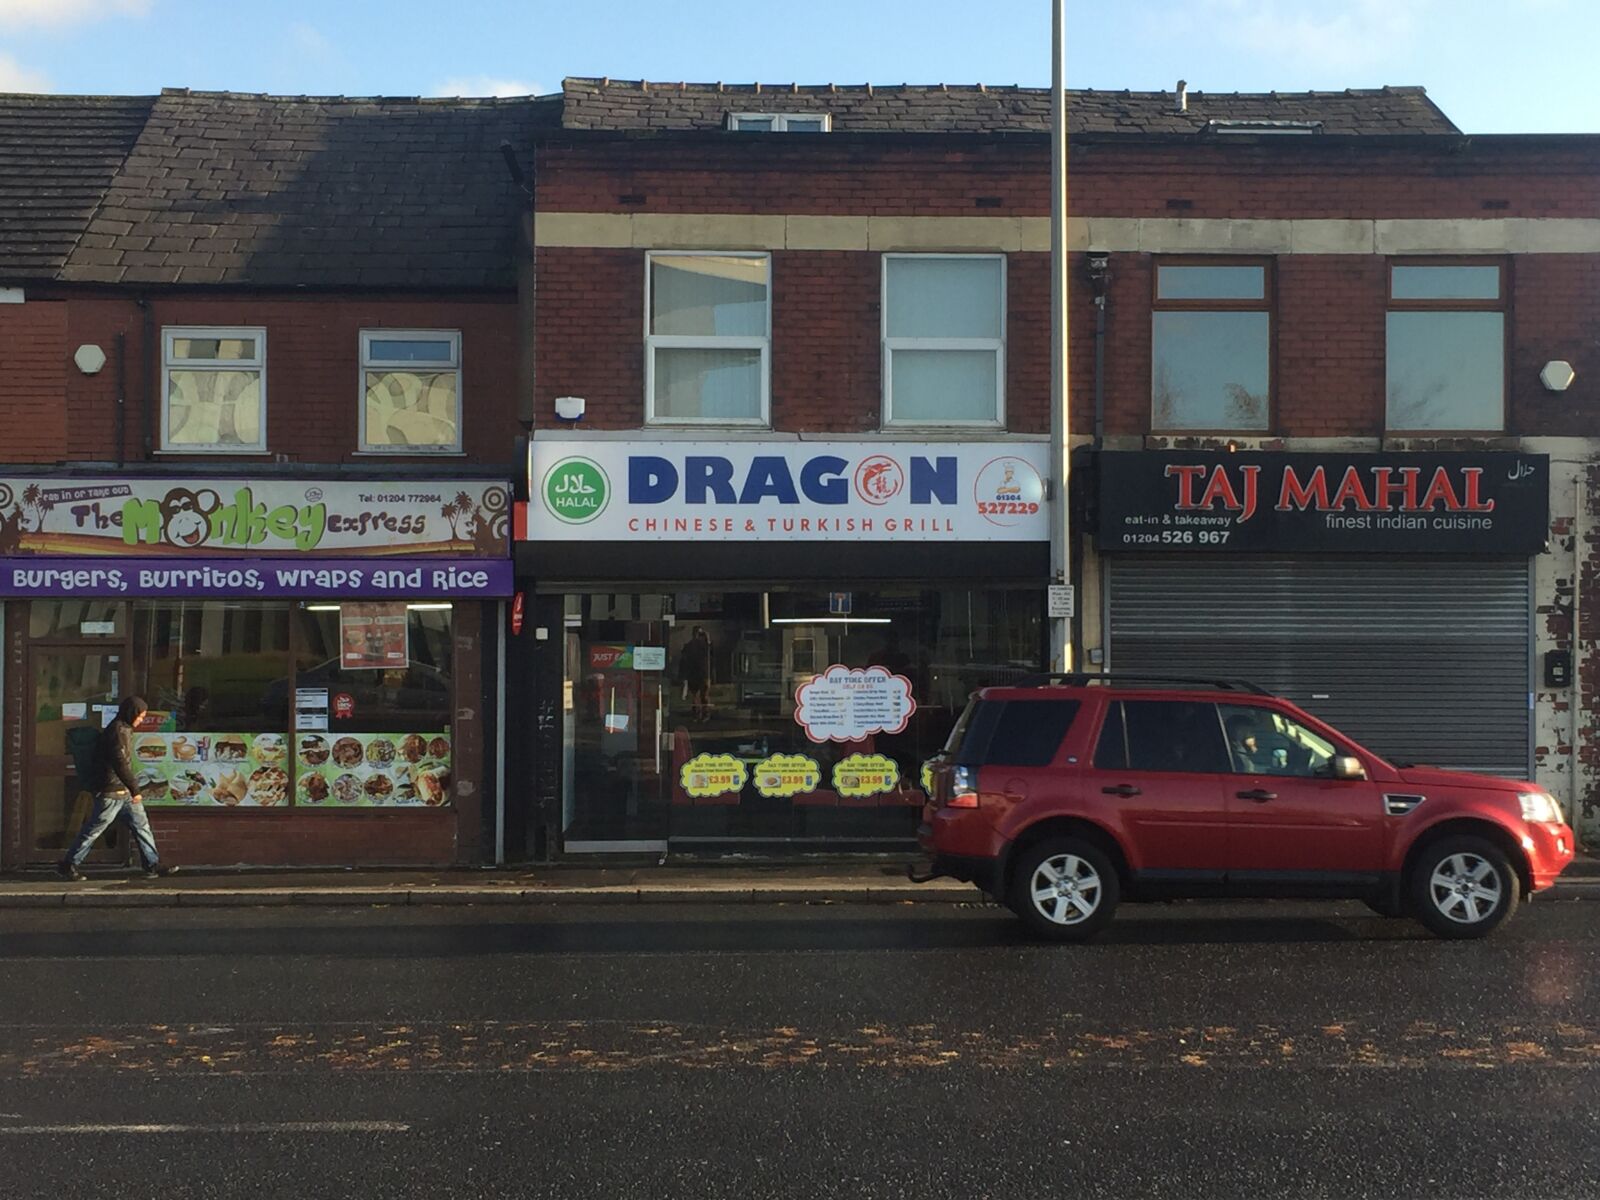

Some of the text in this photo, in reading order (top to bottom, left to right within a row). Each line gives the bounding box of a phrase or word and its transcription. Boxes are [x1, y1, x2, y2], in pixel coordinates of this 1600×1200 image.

[1507, 459, 1536, 480] حلال
[555, 473, 597, 494] حلال
[377, 494, 406, 503] 01204
[1164, 463, 1496, 523] TAJ MAHAL
[555, 496, 598, 508] HALAL
[977, 502, 1040, 515] 527229
[70, 502, 124, 530] The
[1124, 514, 1232, 527] eat-in & takeaway
[1326, 513, 1493, 530] finest indian cuisine
[628, 518, 954, 532] CHINESE & TURKISH GRILL
[1122, 530, 1231, 544] 01204 526 967
[371, 567, 423, 589] and
[432, 566, 489, 591] Rice
[593, 652, 613, 663] JUST
